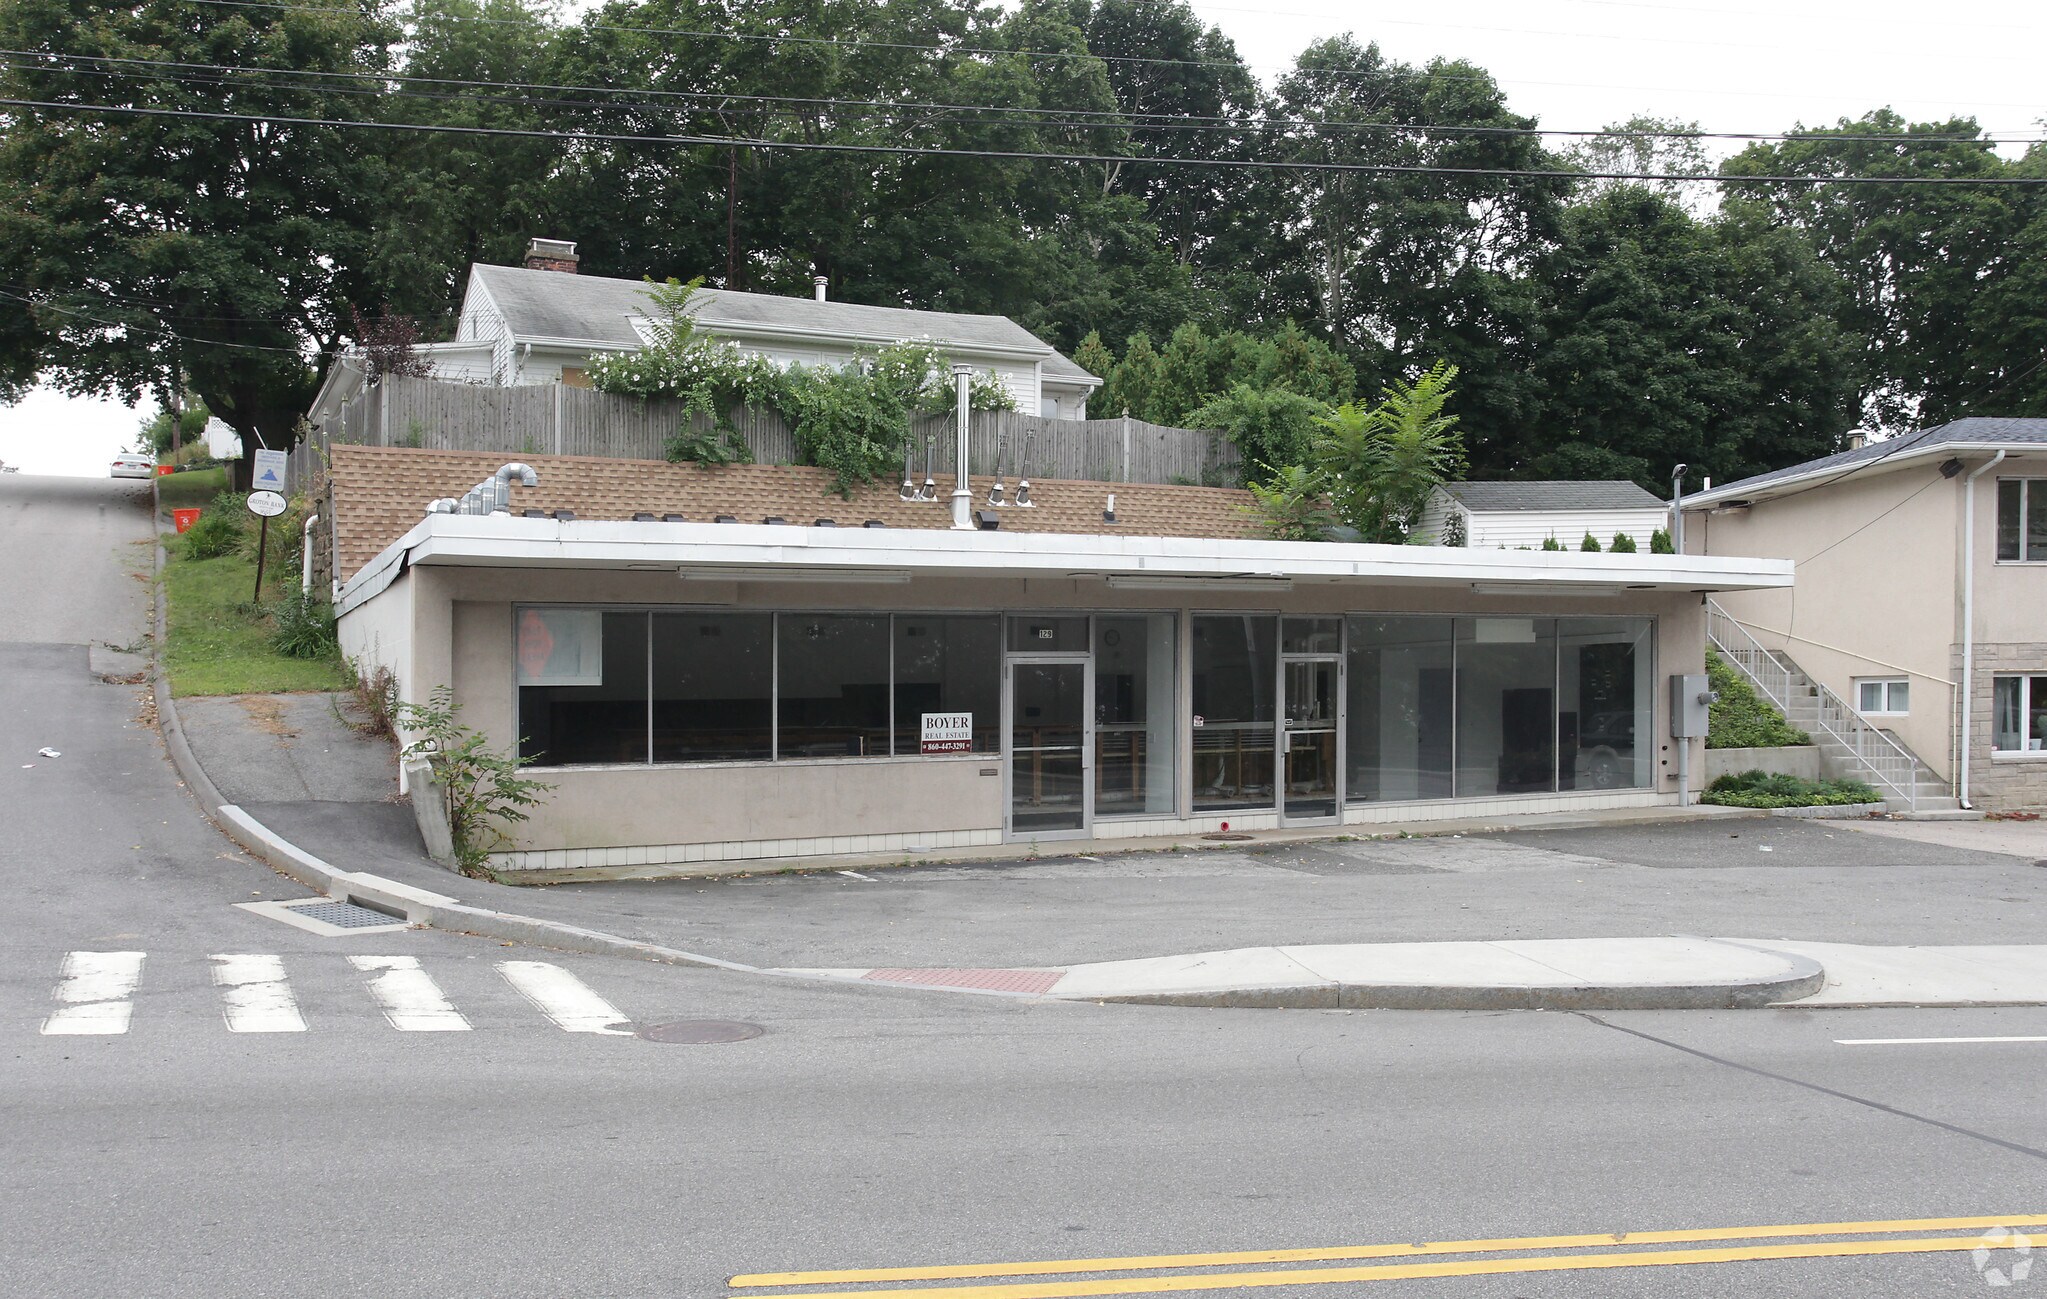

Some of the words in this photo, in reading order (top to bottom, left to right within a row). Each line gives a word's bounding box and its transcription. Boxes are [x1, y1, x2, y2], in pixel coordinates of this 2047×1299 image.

[1040, 630, 1052, 638] 129
[926, 717, 968, 729] BOYER
[925, 732, 943, 740] REAL
